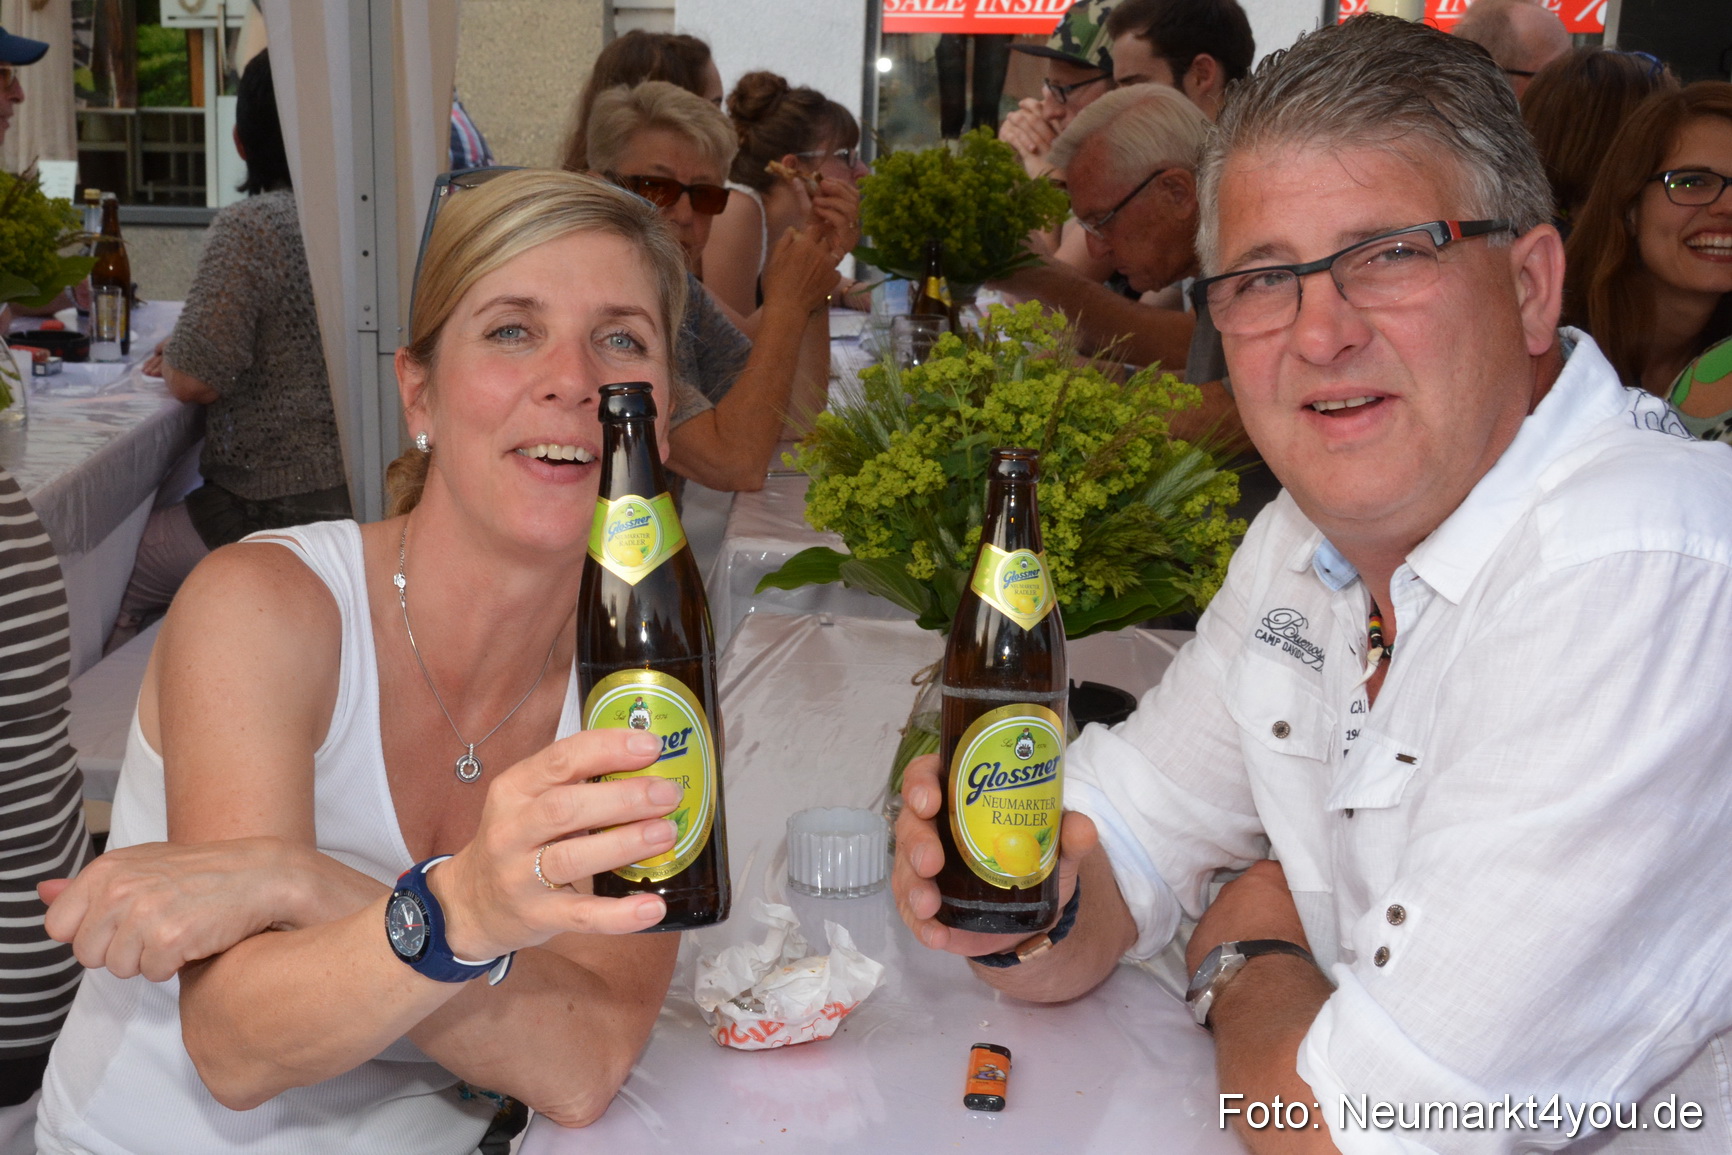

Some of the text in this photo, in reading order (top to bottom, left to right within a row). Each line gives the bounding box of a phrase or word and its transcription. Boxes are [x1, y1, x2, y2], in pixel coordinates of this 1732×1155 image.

[883, 0, 1078, 13] SALE INSID
[608, 515, 652, 542] Glossner
[619, 539, 646, 547] RADLER
[1003, 569, 1040, 589] Glossner
[1255, 629, 1302, 659] CAMP DAVID
[966, 756, 1061, 806] Glossner
[981, 795, 1057, 811] NEUMARKTER
[991, 810, 1048, 828] RADLER
